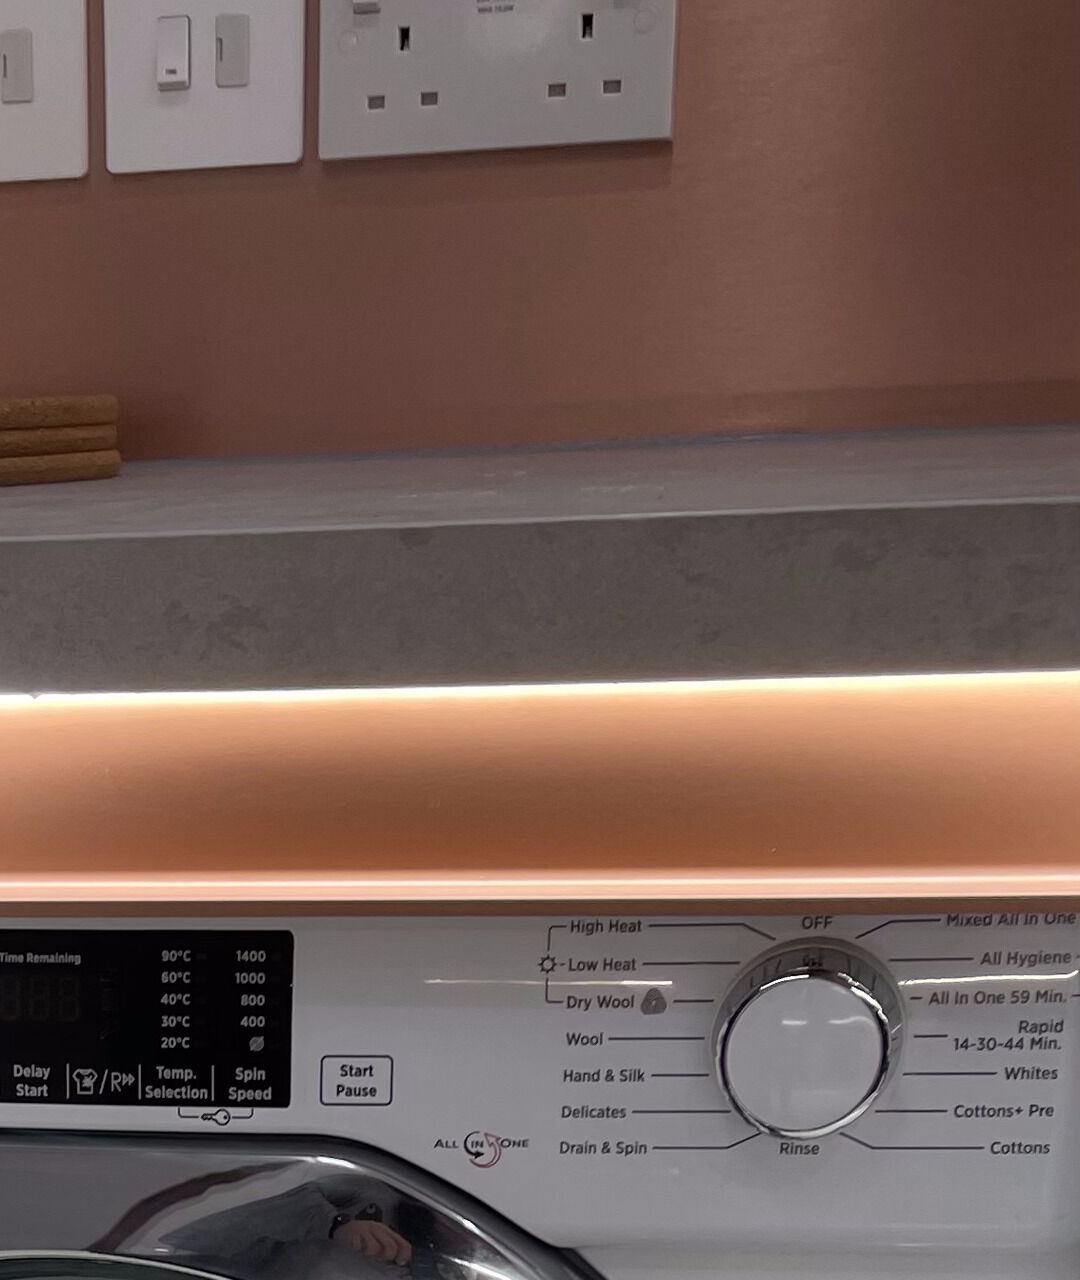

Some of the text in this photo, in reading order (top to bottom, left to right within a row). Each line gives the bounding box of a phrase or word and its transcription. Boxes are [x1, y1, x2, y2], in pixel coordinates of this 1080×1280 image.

[801, 916, 835, 930] OFF
[946, 913, 993, 926] Mixed
[998, 913, 1019, 926] All
[1023, 913, 1038, 925] In
[570, 919, 642, 935] High Heat
[0, 952, 82, 965] Time Remaining
[161, 950, 191, 962] 90°C
[236, 950, 266, 962] 1400
[980, 950, 1072, 967] All Hygiene
[568, 958, 637, 971] Low Heat
[161, 971, 191, 983] 60°C
[235, 972, 266, 984] 1000
[160, 993, 191, 1005] 40°C
[240, 994, 266, 1006] 800
[566, 995, 635, 1011] Dry Wool
[928, 989, 1068, 1005] All In One 59 Min.
[161, 1015, 190, 1027] 30°C
[240, 1015, 266, 1027] 400
[1018, 1019, 1064, 1035] Rapid
[160, 1037, 190, 1049] 20°C
[566, 1032, 603, 1046] Wool
[954, 1037, 1062, 1051] 14-30-44 Min.
[13, 1064, 50, 1080] Delay
[155, 1066, 197, 1081] Temp.
[235, 1066, 266, 1082] Spin
[339, 1064, 374, 1078] Start
[563, 1068, 645, 1082] Hand & Silk
[1004, 1067, 1058, 1080] Whites
[16, 1083, 48, 1097] Start
[145, 1085, 208, 1099] Selection
[228, 1087, 272, 1101] Speed
[336, 1084, 377, 1097] Pause
[561, 1105, 627, 1119] Delicates
[953, 1104, 1055, 1118] Cottons+ Pre
[433, 1138, 529, 1149] ALL IN ONE
[560, 1141, 648, 1157] Drain & Spin
[779, 1142, 820, 1155] Rinse
[990, 1141, 1050, 1155] Cottons
